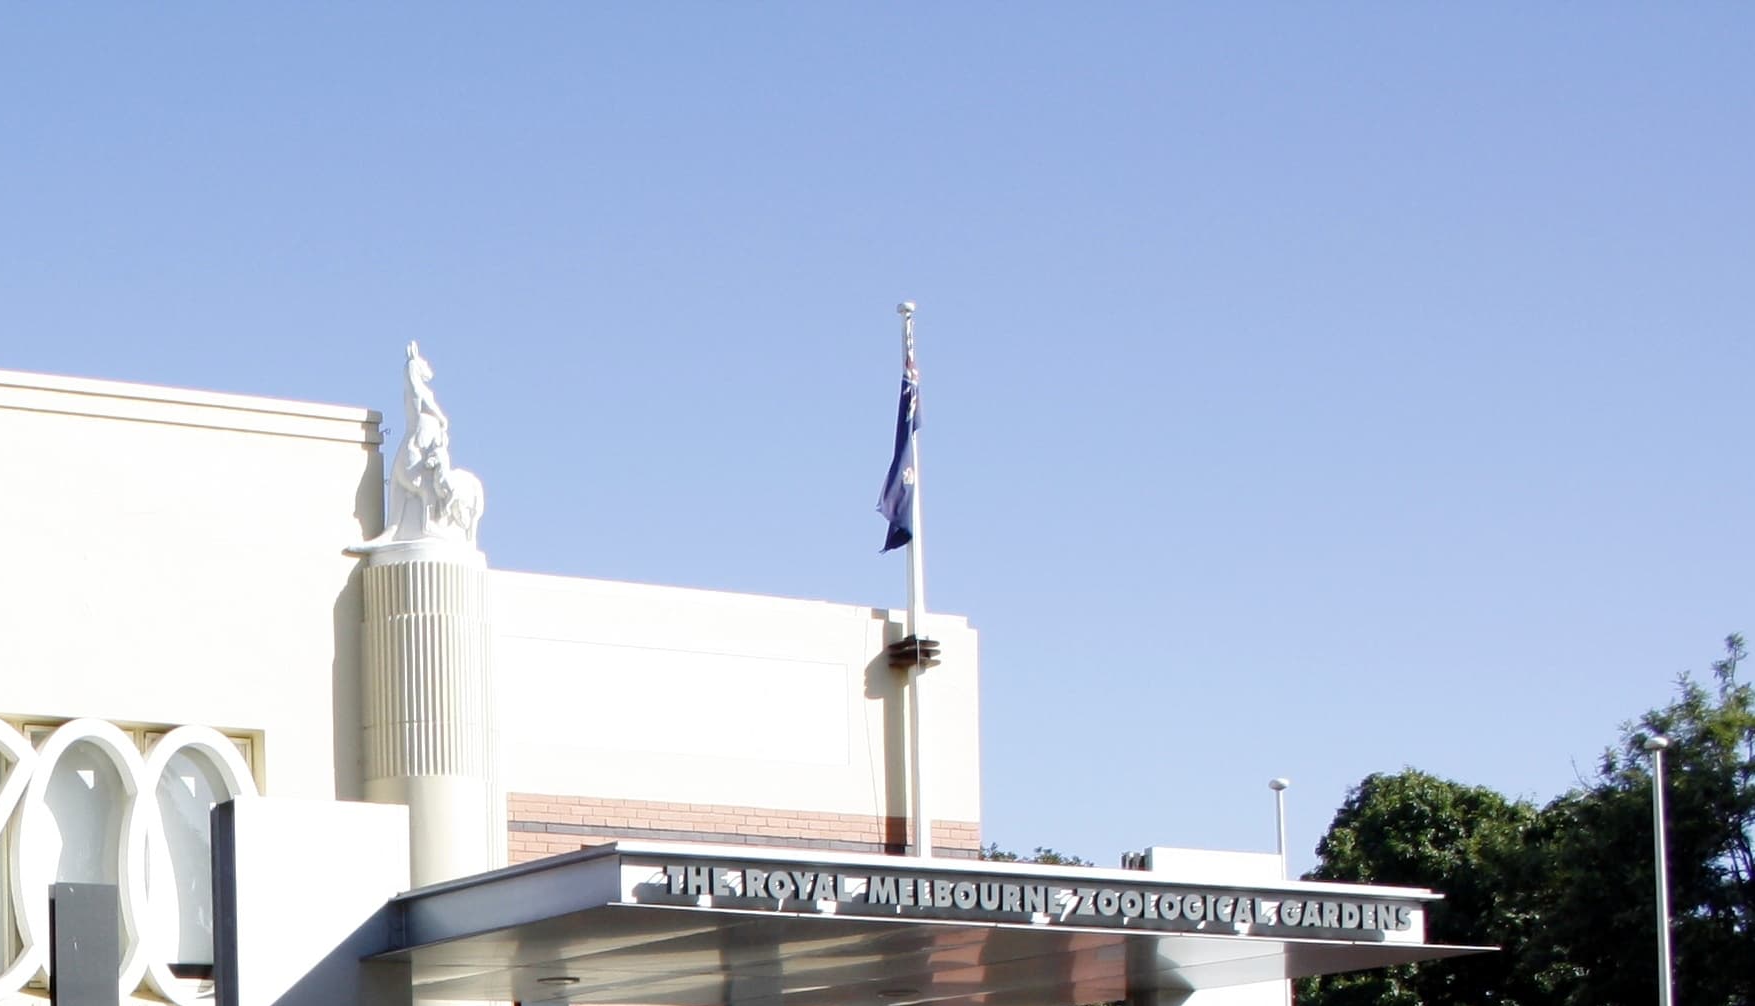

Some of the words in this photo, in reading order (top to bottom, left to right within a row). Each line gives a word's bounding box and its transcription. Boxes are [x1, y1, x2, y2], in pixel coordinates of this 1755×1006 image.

[667, 866, 730, 896] THE
[746, 869, 853, 902] ROYAL
[868, 876, 1062, 914] MELBOURNE
[1075, 888, 1268, 925] ZOOLOGICAL
[1280, 900, 1412, 930] GARDENS
